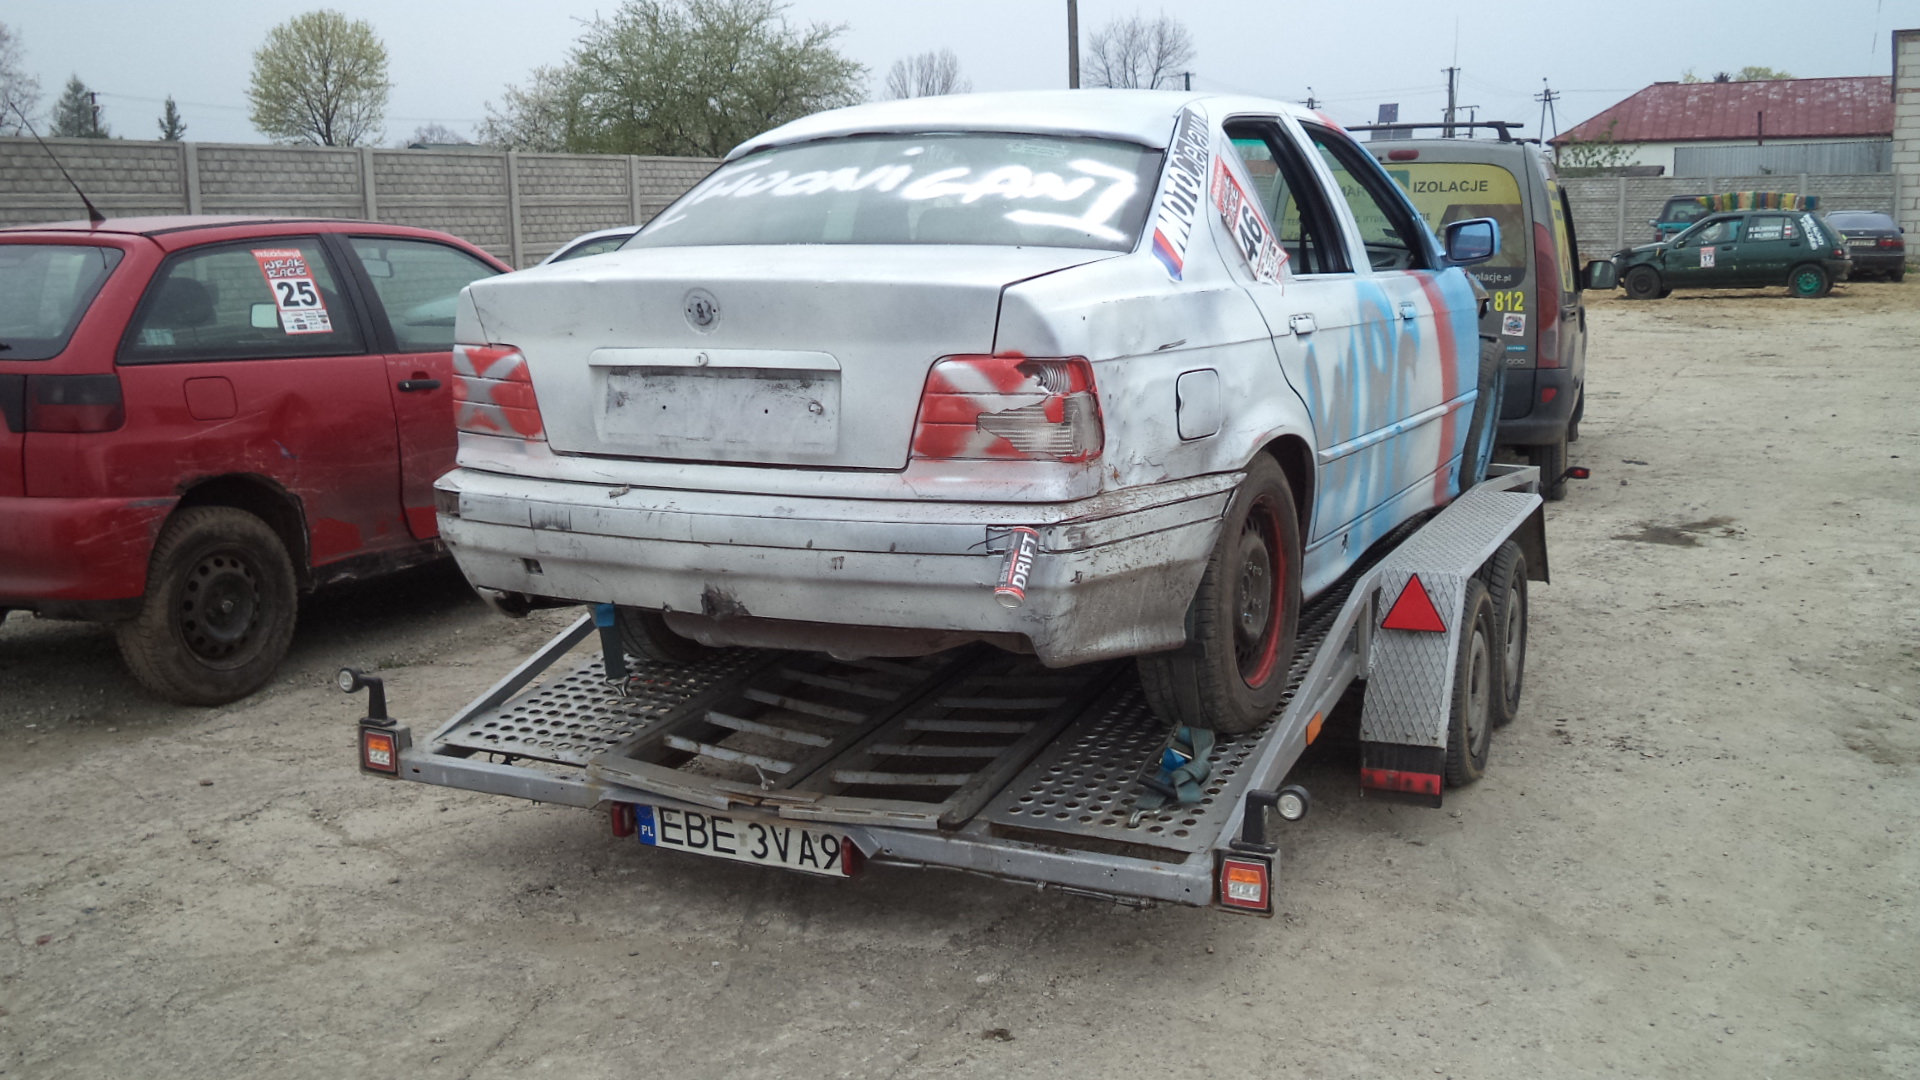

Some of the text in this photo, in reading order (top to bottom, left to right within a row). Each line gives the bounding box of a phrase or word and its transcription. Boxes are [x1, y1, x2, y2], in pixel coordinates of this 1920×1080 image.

[1413, 180, 1488, 193] IZOLACJE
[1238, 205, 1262, 262] 46
[264, 258, 305, 270] WRAK
[267, 267, 307, 279] RACE
[277, 281, 317, 307] 25
[1494, 291, 1525, 312] 812
[1012, 532, 1037, 591] DRIFT
[641, 825, 654, 837] PL
[659, 807, 841, 870] EBE 3VA9
